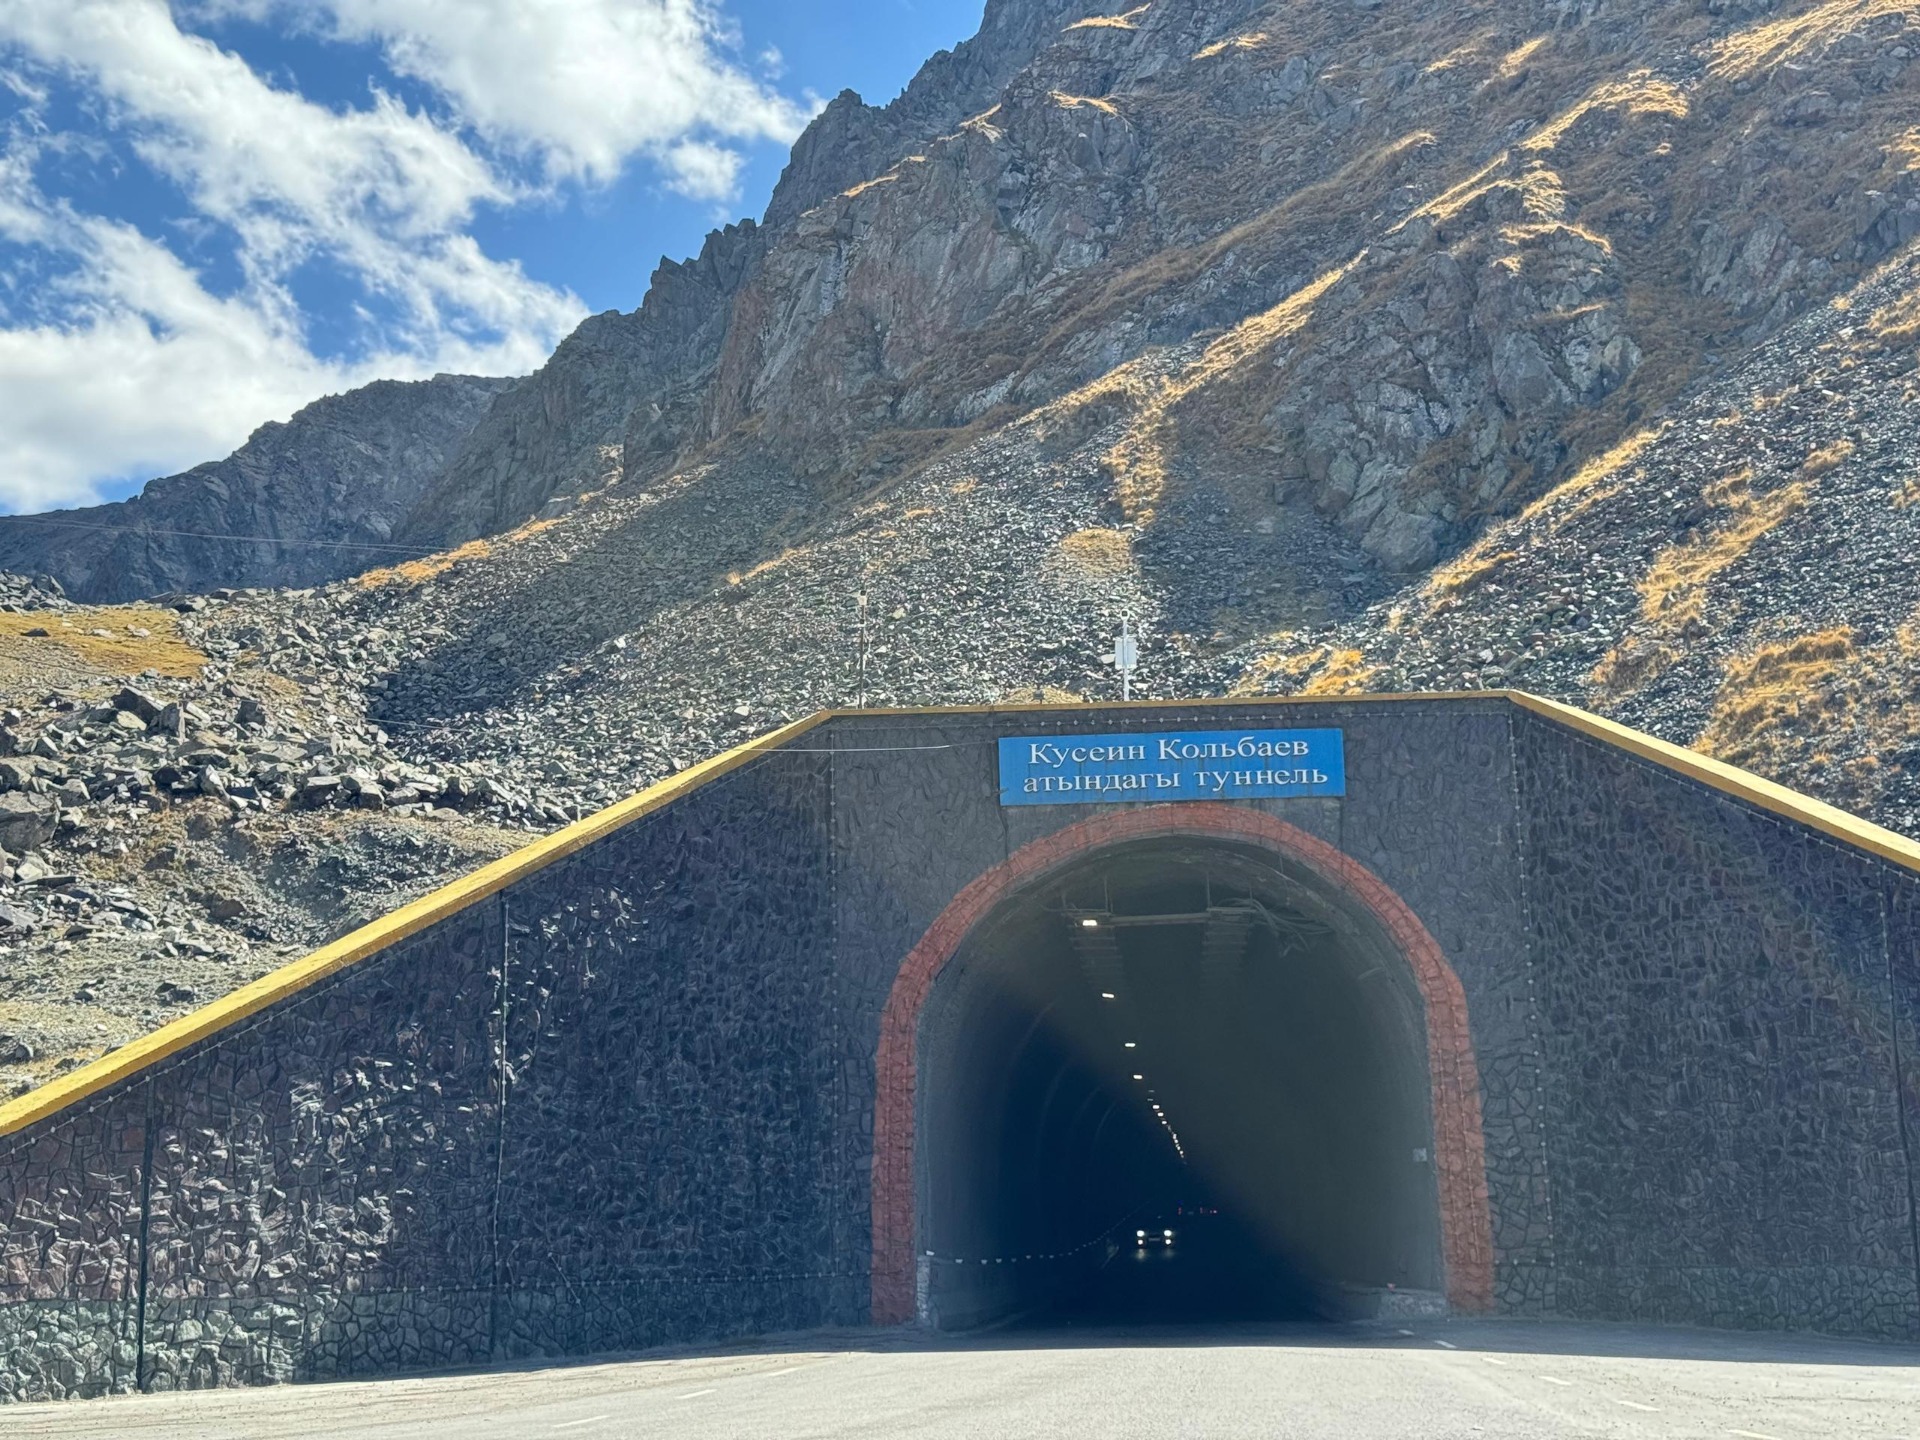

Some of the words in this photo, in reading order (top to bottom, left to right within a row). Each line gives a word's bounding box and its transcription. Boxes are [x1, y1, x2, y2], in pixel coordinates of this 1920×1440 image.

[1028, 743, 1145, 768] Кусеин
[1158, 736, 1309, 760] Кольбаев
[1023, 773, 1181, 793] атындагы
[1193, 768, 1328, 792] туннель
